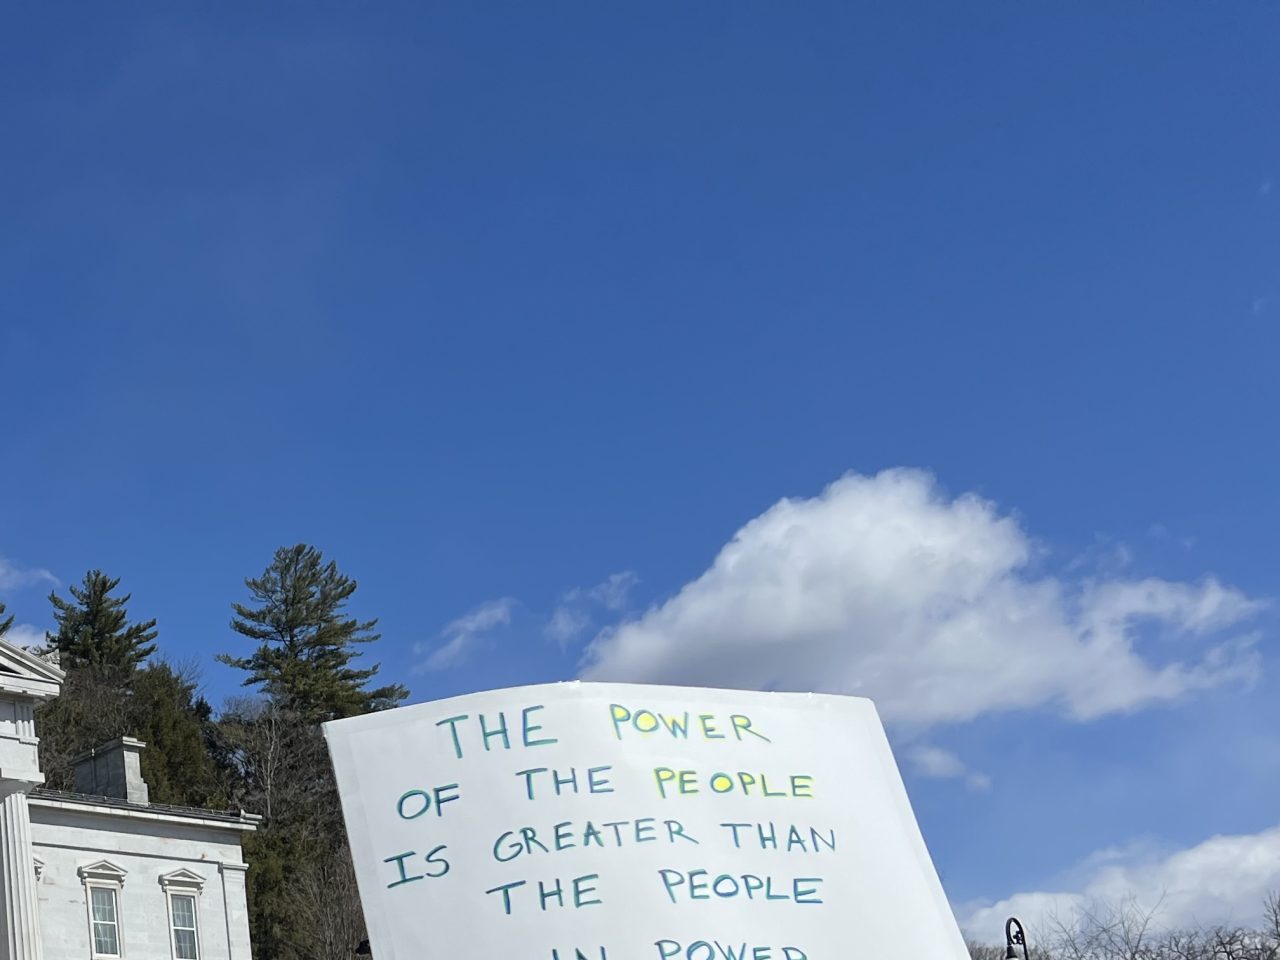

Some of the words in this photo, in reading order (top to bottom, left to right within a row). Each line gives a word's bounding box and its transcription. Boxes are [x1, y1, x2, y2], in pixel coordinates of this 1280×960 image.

[435, 704, 558, 758] THE
[609, 703, 772, 742] POWER
[397, 783, 461, 819] OF
[515, 766, 615, 801] THE
[653, 766, 815, 799] PEOPLE
[383, 845, 450, 889] IS
[493, 818, 699, 863] GREATER
[723, 821, 837, 853] THAN
[486, 873, 603, 914] THE
[660, 868, 824, 904] PEOPLE
